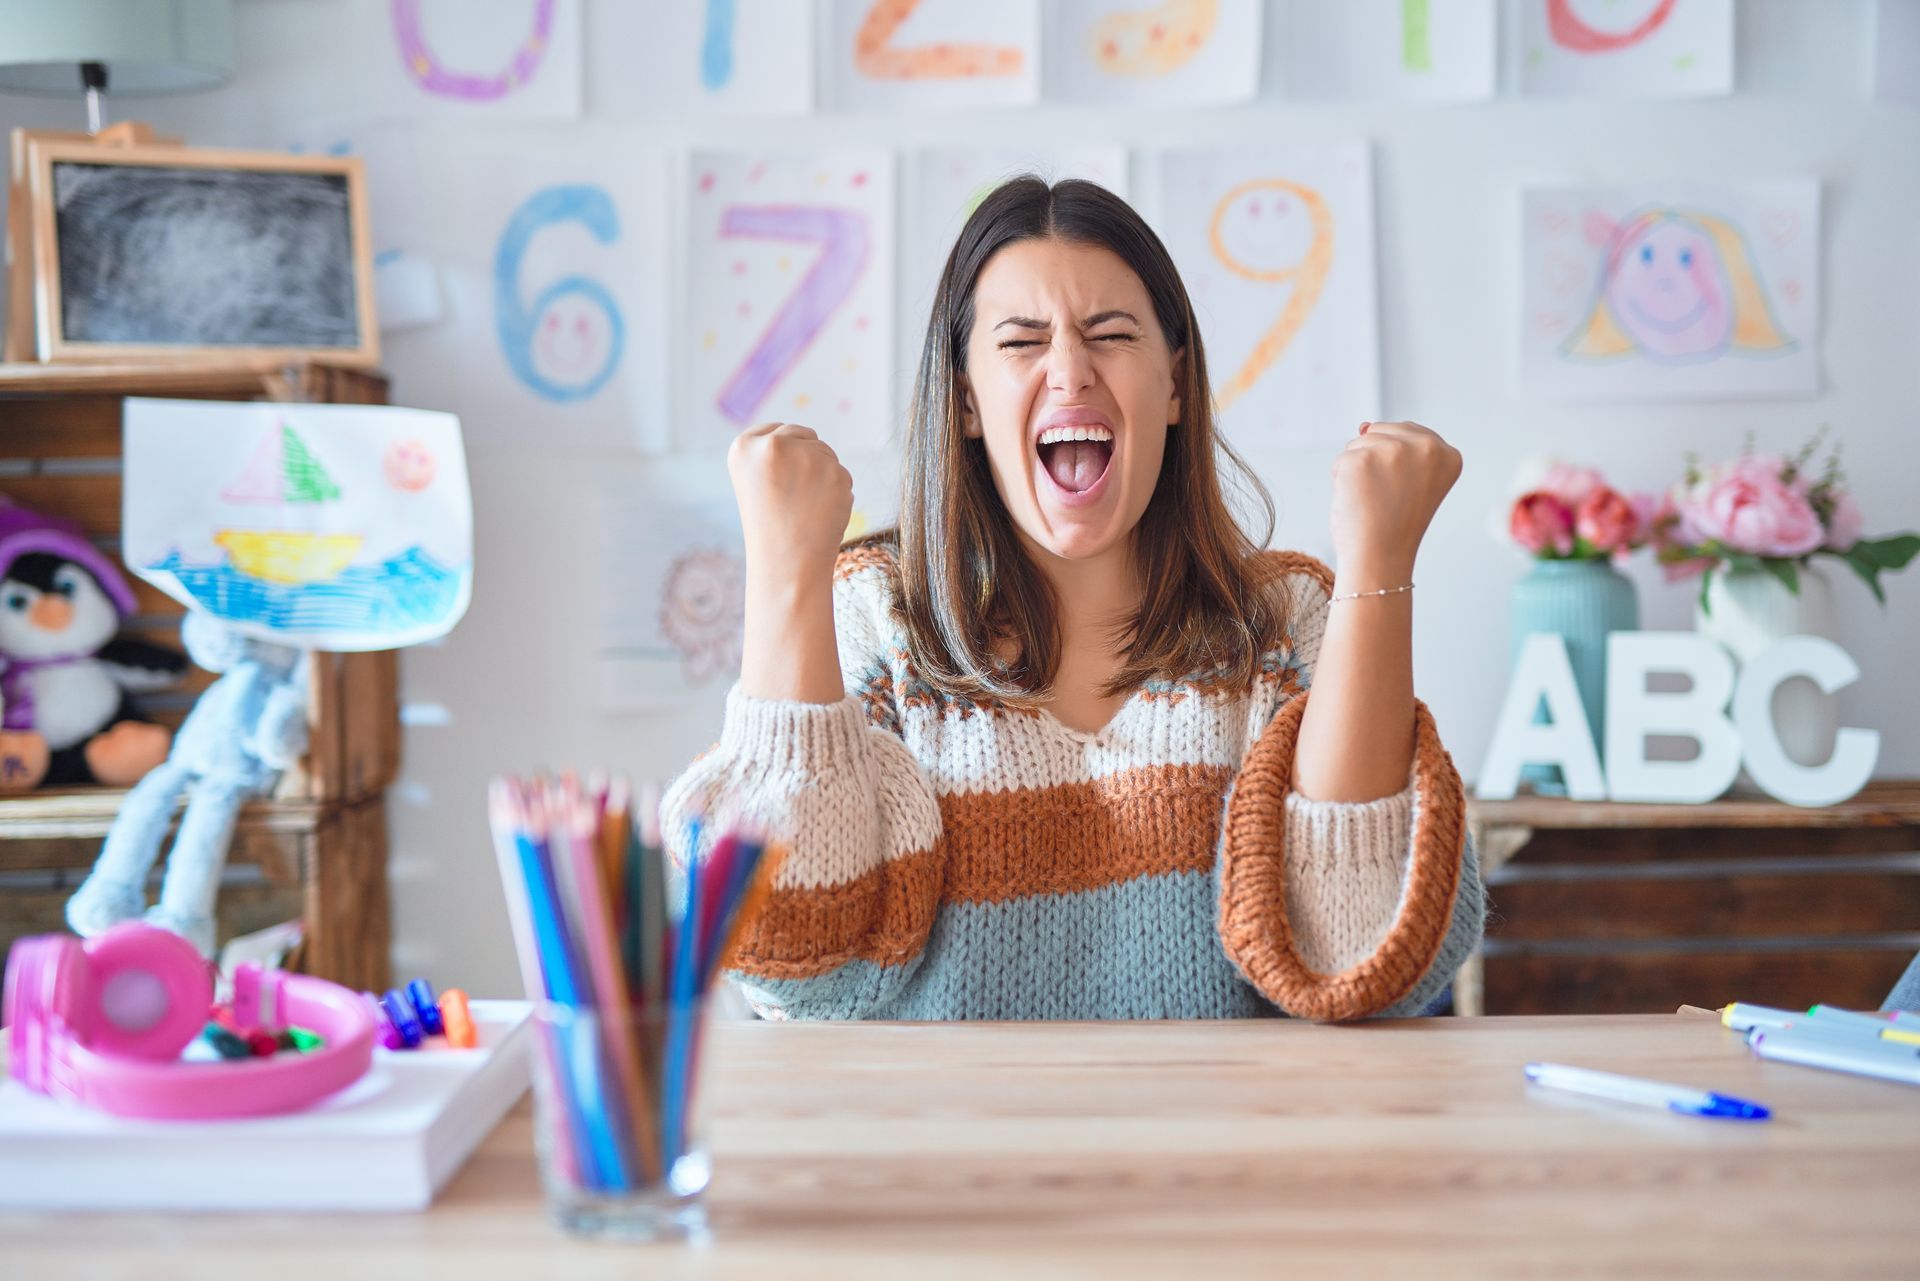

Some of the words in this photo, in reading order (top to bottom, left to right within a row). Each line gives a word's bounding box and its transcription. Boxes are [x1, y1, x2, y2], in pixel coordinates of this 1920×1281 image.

[494, 184, 625, 406] 6
[717, 204, 872, 424] 7
[1208, 177, 1336, 412] 9
[1476, 630, 1880, 808] ABC
